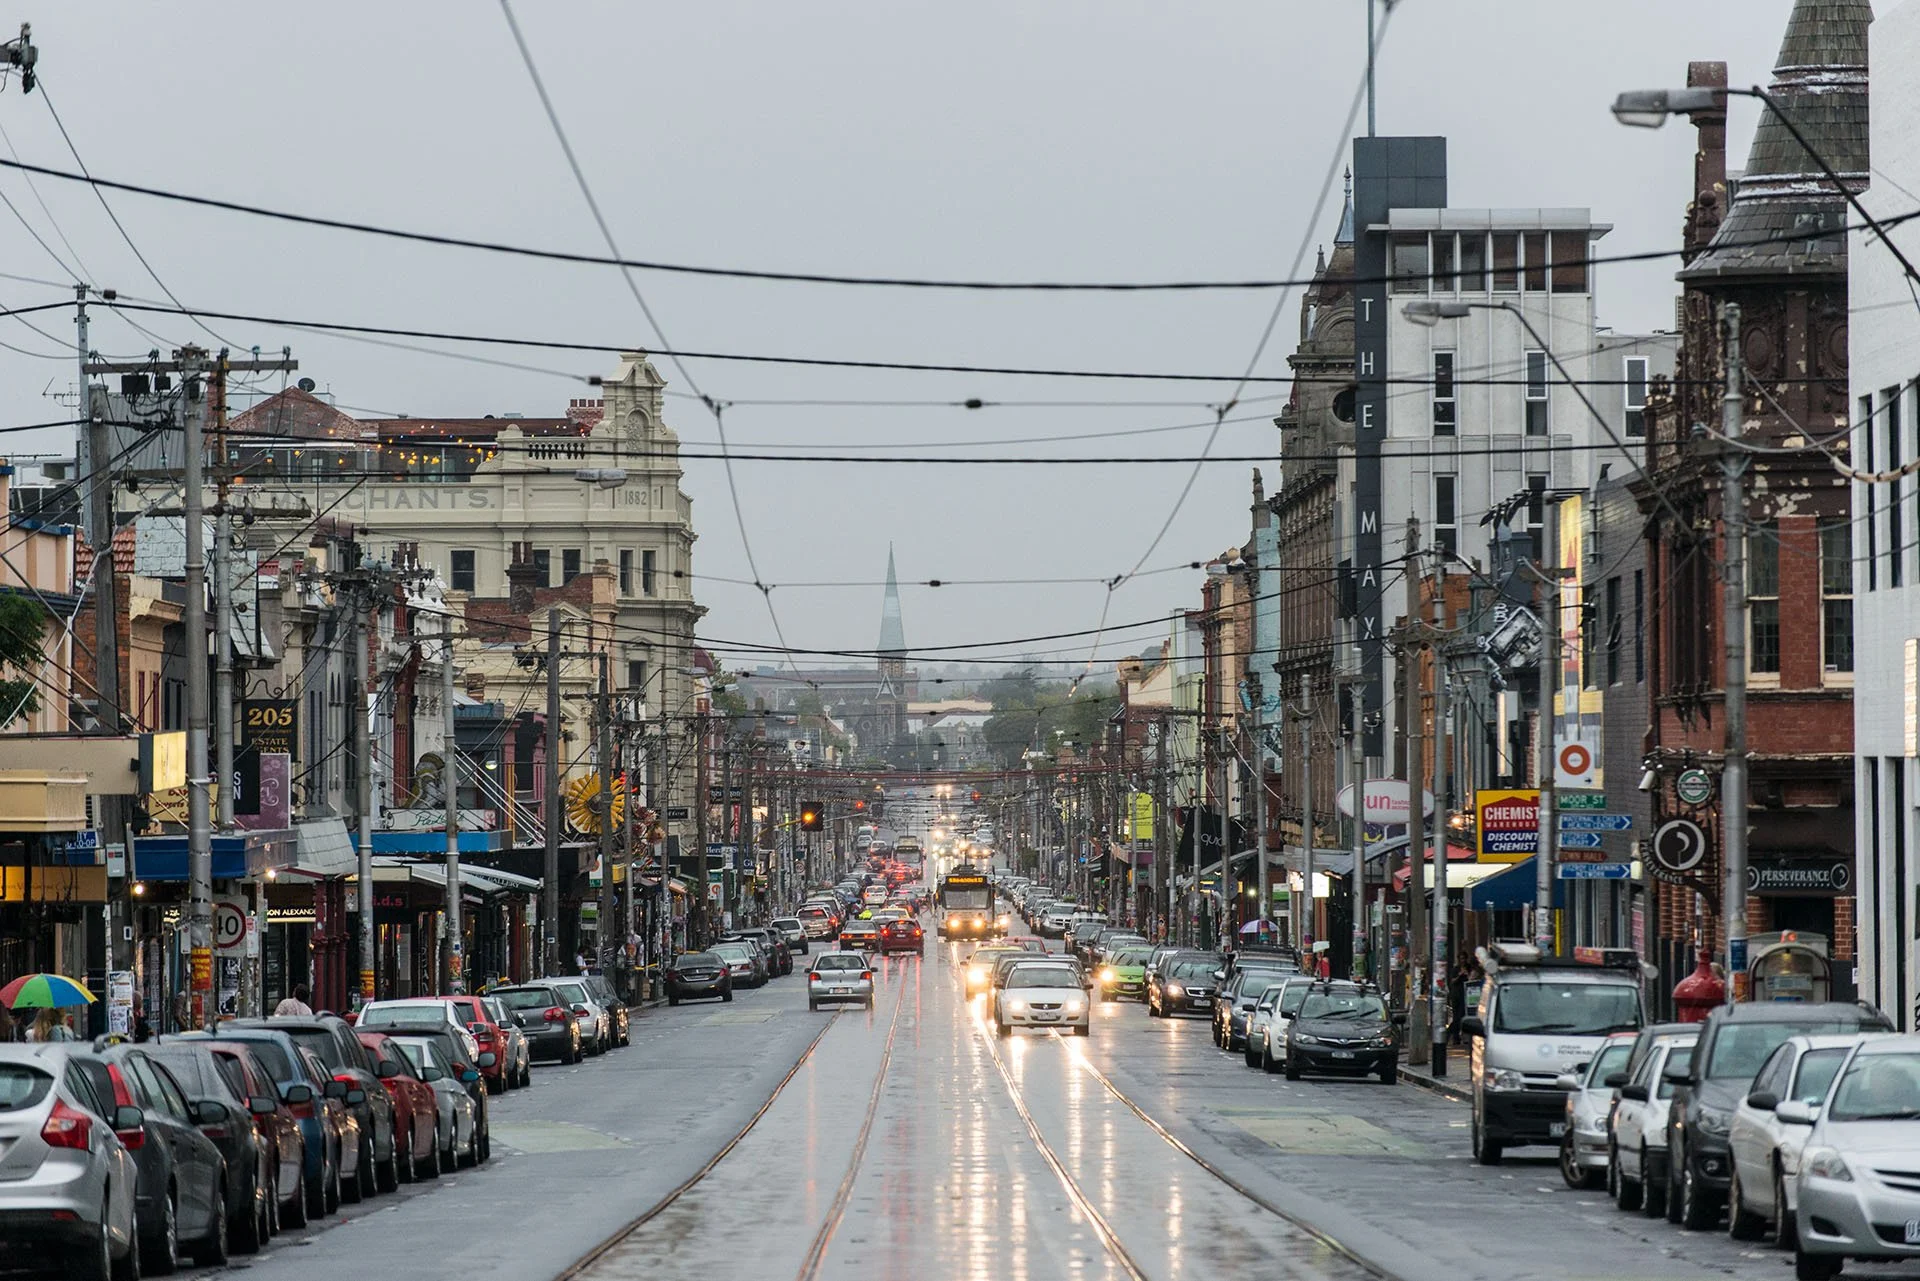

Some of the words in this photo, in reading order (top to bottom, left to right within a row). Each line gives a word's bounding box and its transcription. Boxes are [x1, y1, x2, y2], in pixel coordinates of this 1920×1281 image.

[1361, 298, 1374, 429] THE
[625, 491, 647, 506] 1882
[1361, 511, 1377, 640] MAX
[248, 707, 292, 726] 205
[252, 738, 288, 746] ESTATE
[1560, 795, 1587, 805] MOOR
[1592, 795, 1604, 805] ST
[1484, 806, 1540, 820] CHEMIST
[1487, 832, 1539, 842] DISCOUNT
[1492, 842, 1536, 851] CHEMIST
[1761, 869, 1830, 881] PERSEVERANCE
